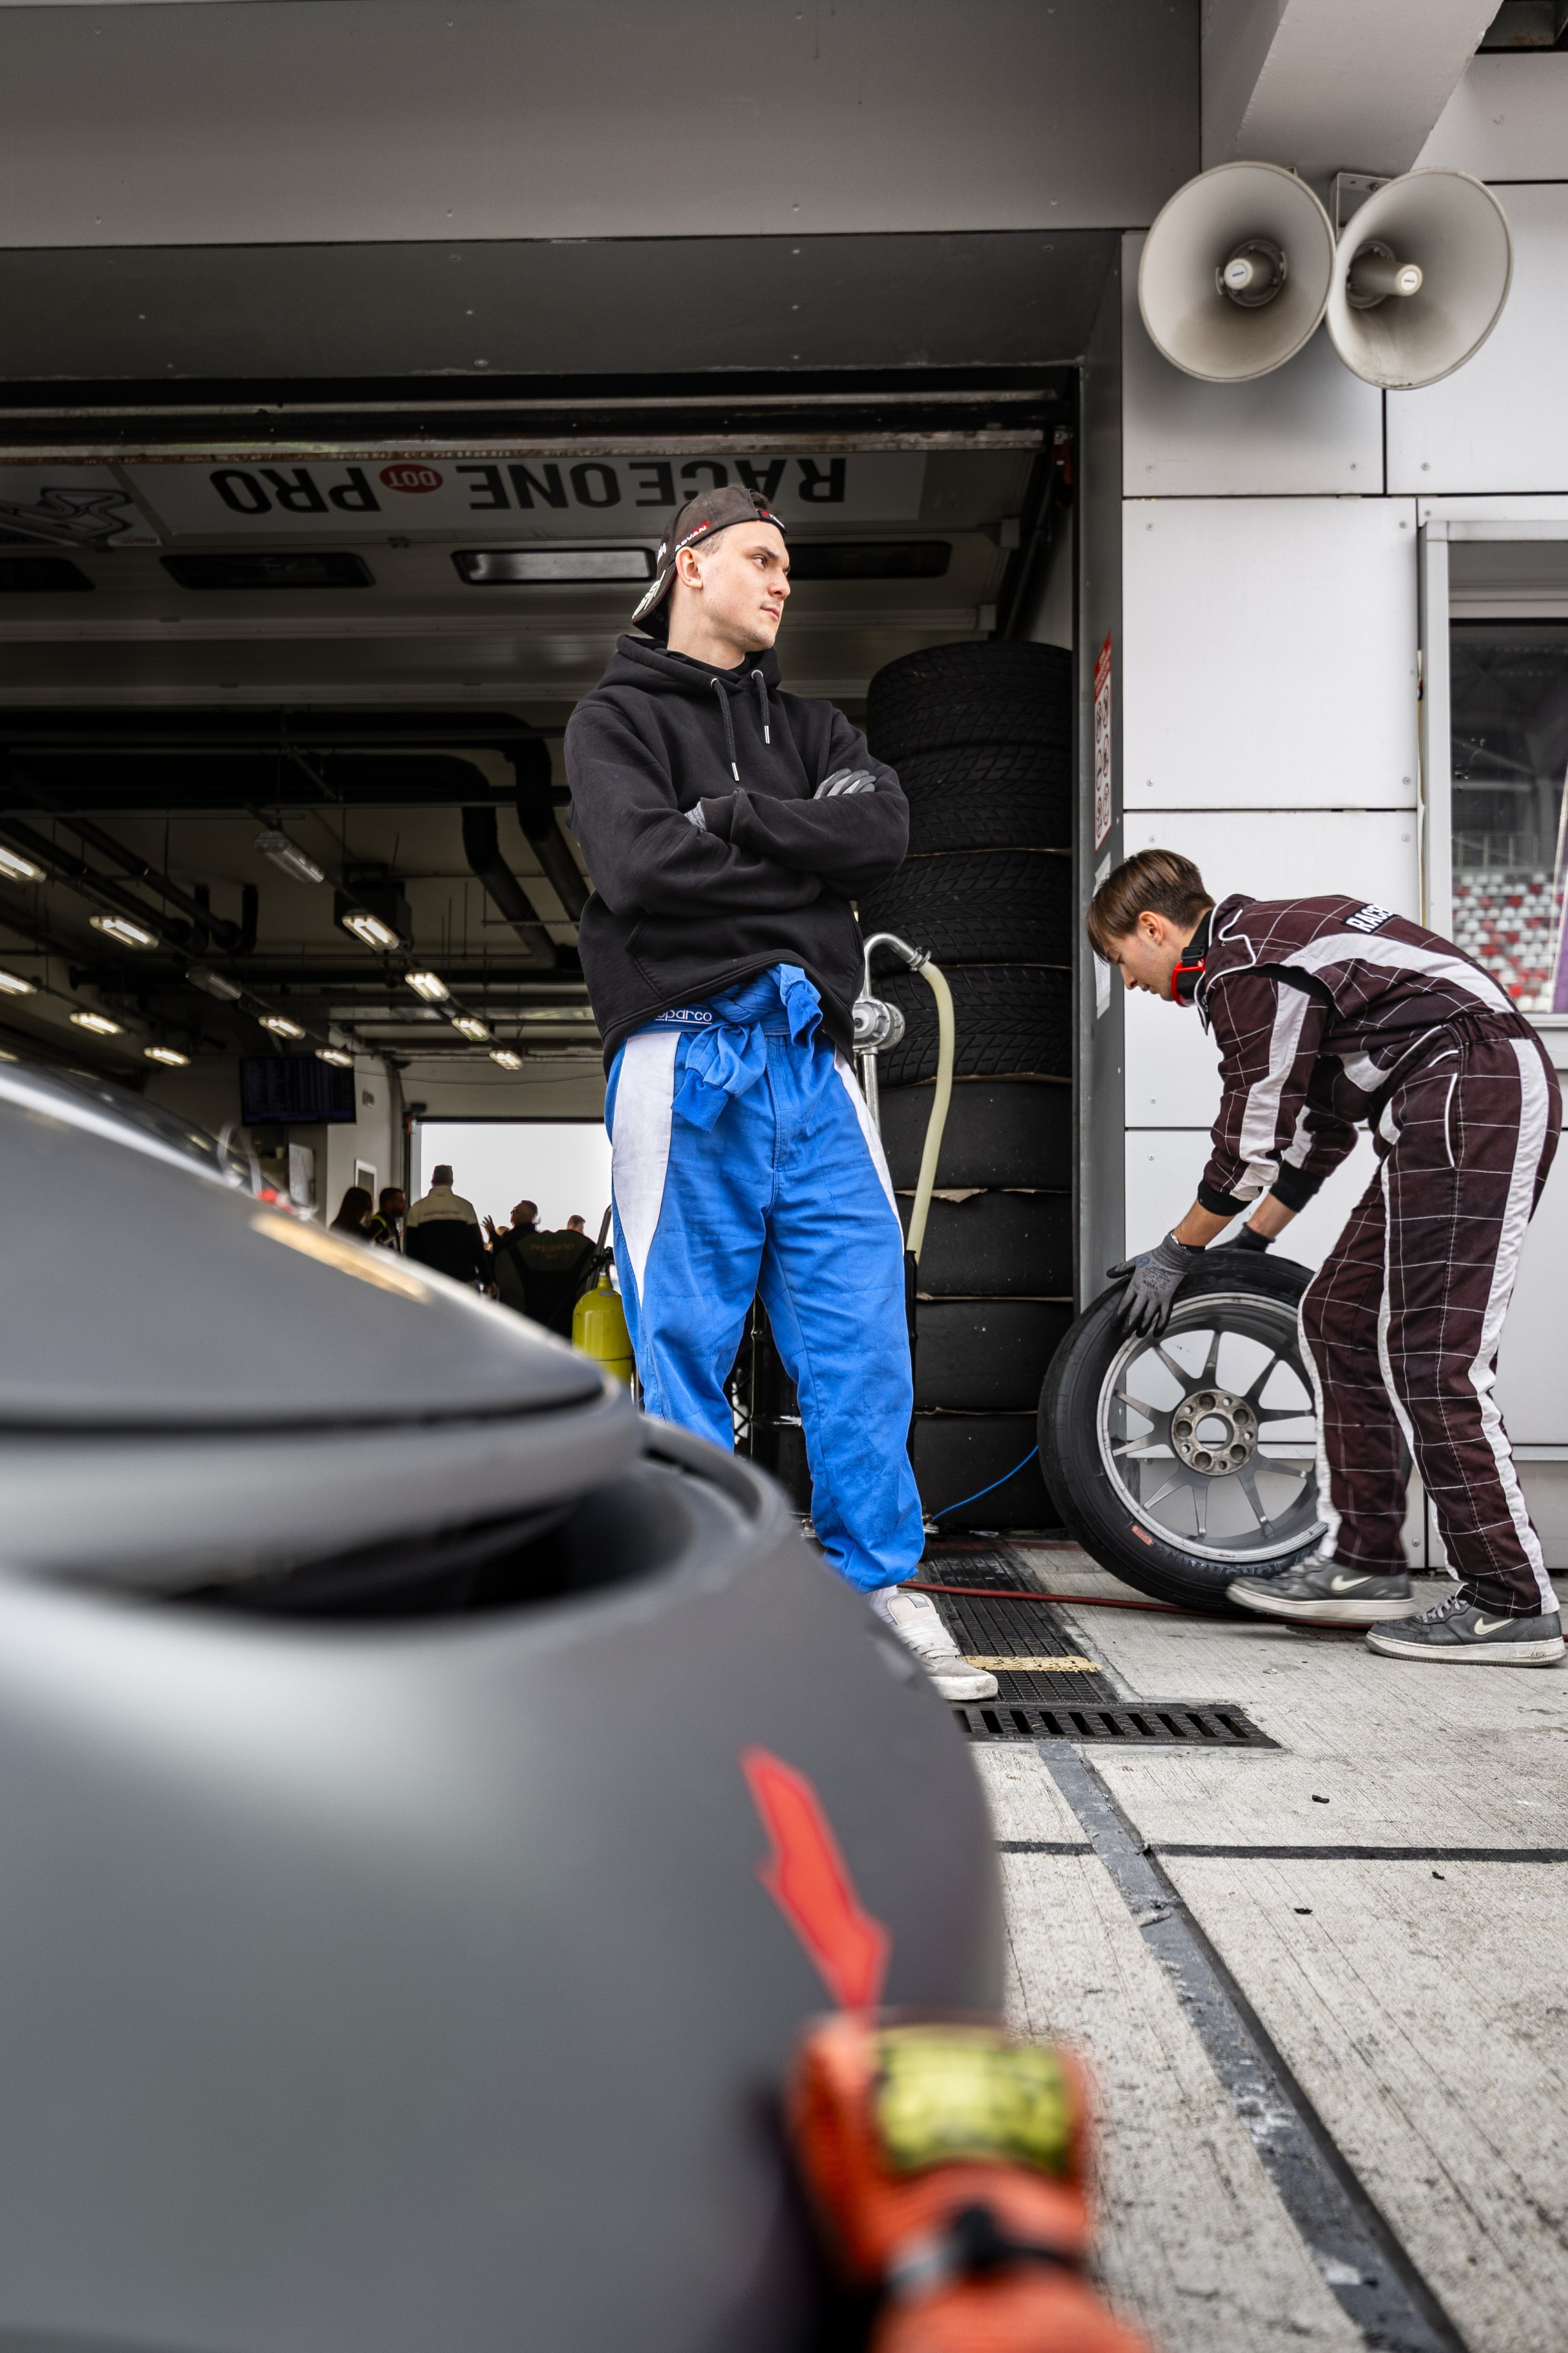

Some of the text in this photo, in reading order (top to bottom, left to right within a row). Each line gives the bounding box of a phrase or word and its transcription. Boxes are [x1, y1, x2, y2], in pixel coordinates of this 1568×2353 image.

[209, 467, 381, 515] PRO
[389, 470, 437, 488] DOT
[674, 525, 707, 551] ADVAN
